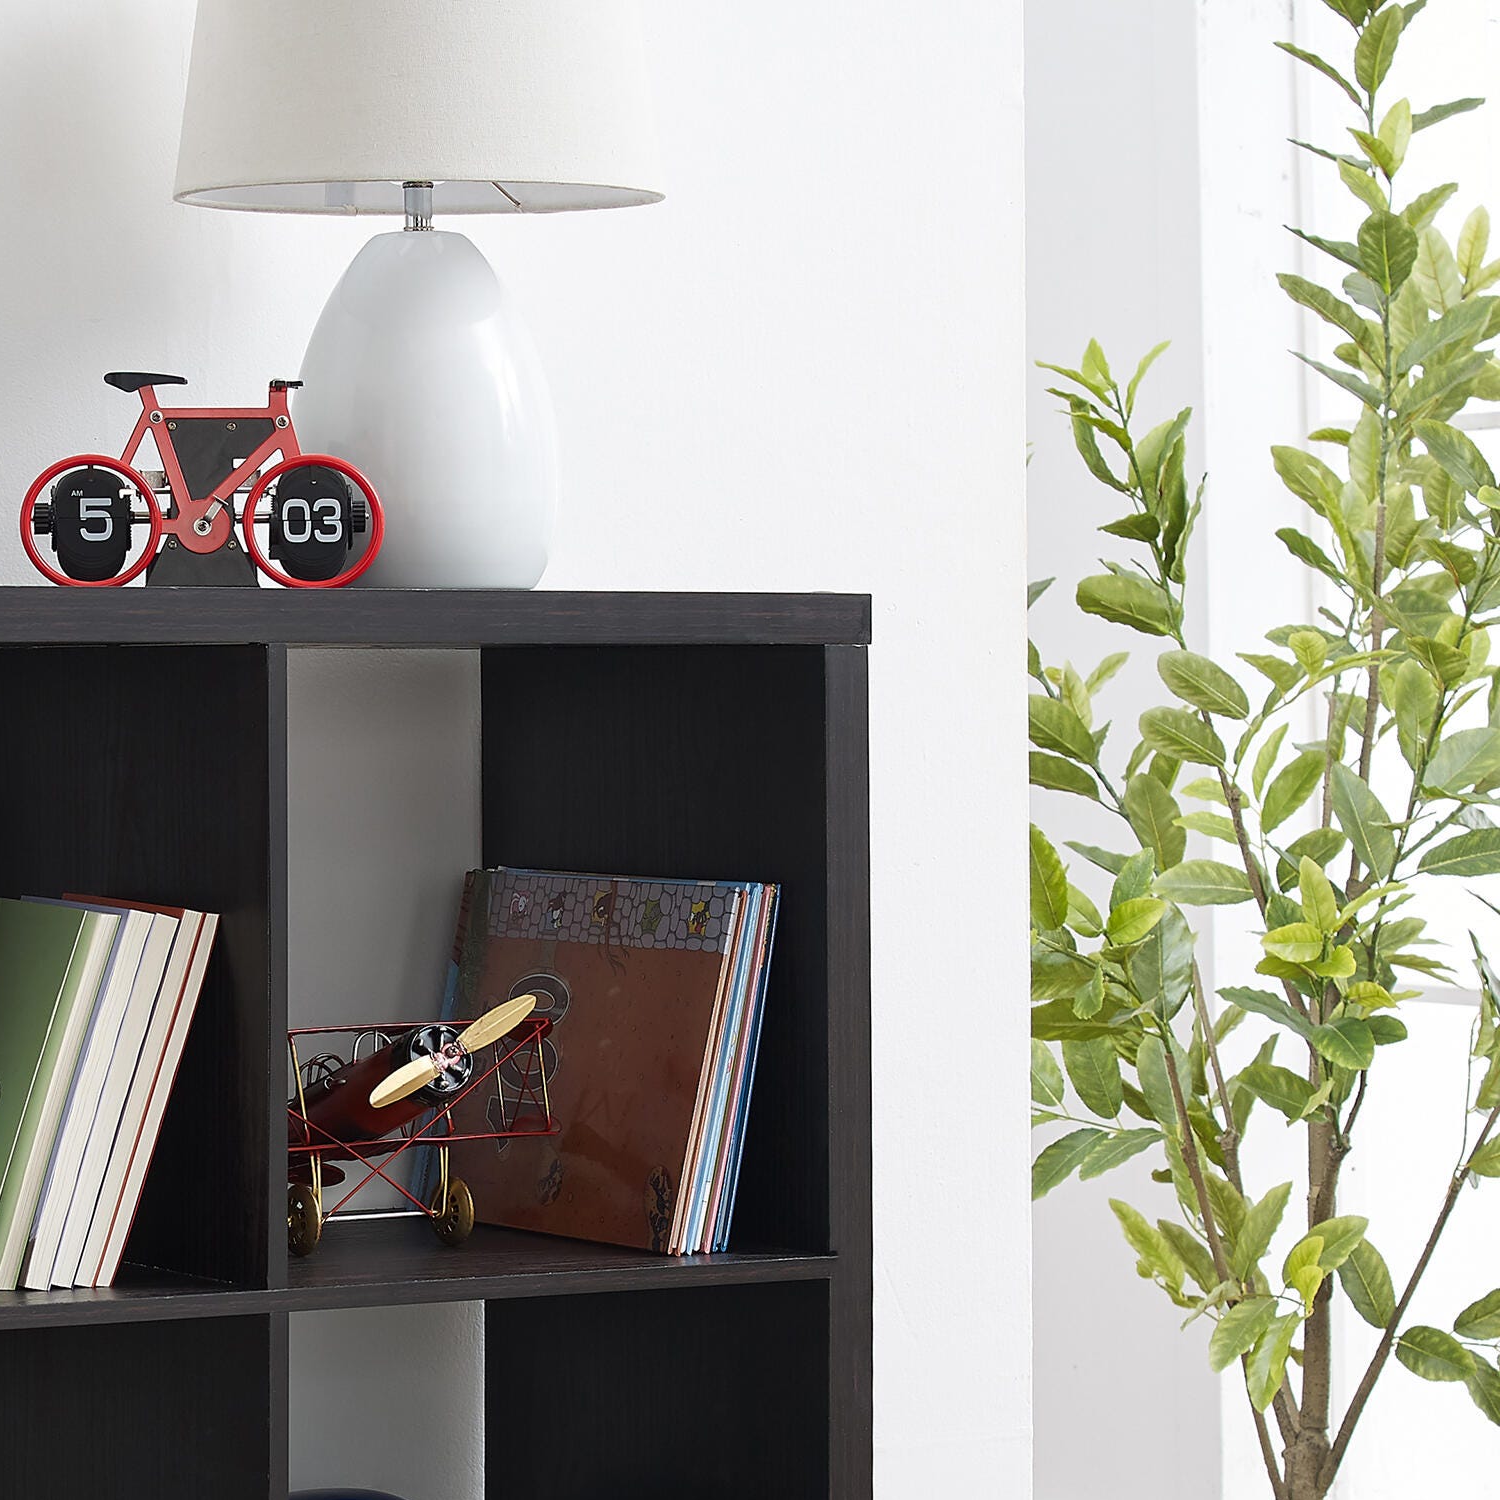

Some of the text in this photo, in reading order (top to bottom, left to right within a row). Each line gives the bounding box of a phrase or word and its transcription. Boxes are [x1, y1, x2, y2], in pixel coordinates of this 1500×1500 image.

[70, 489, 84, 497] AM
[79, 497, 113, 541] 5
[282, 498, 343, 543] 03
